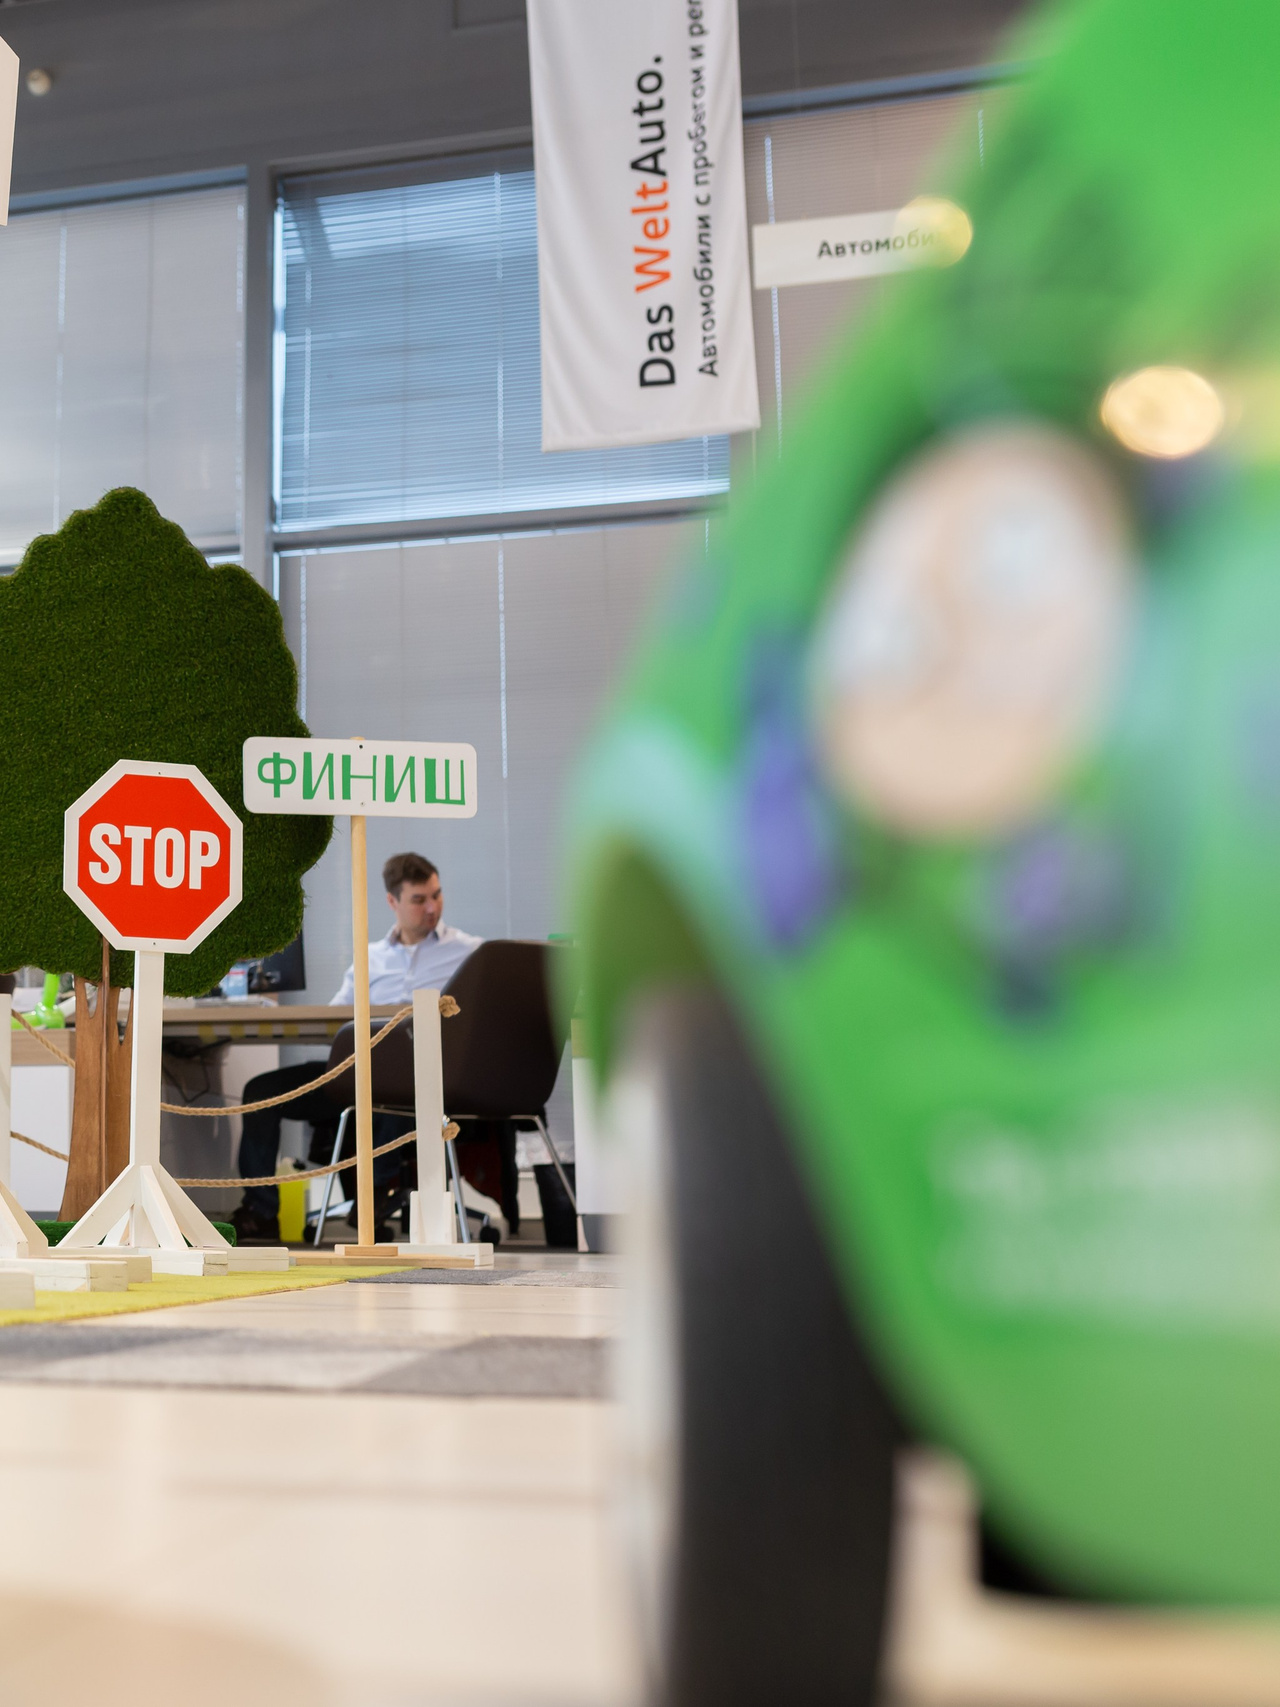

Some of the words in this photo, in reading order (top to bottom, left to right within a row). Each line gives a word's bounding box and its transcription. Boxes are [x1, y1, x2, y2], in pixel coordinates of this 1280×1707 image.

[690, 44, 705, 60] и
[688, 66, 714, 187] пробегом
[630, 55, 672, 294] WeltAuto.
[695, 193, 712, 206] с
[818, 228, 941, 260] Автомоби
[693, 214, 719, 378] Автомобили
[638, 303, 676, 388] Das
[257, 752, 466, 805] ФИНИШ
[88, 822, 221, 890] STOP
